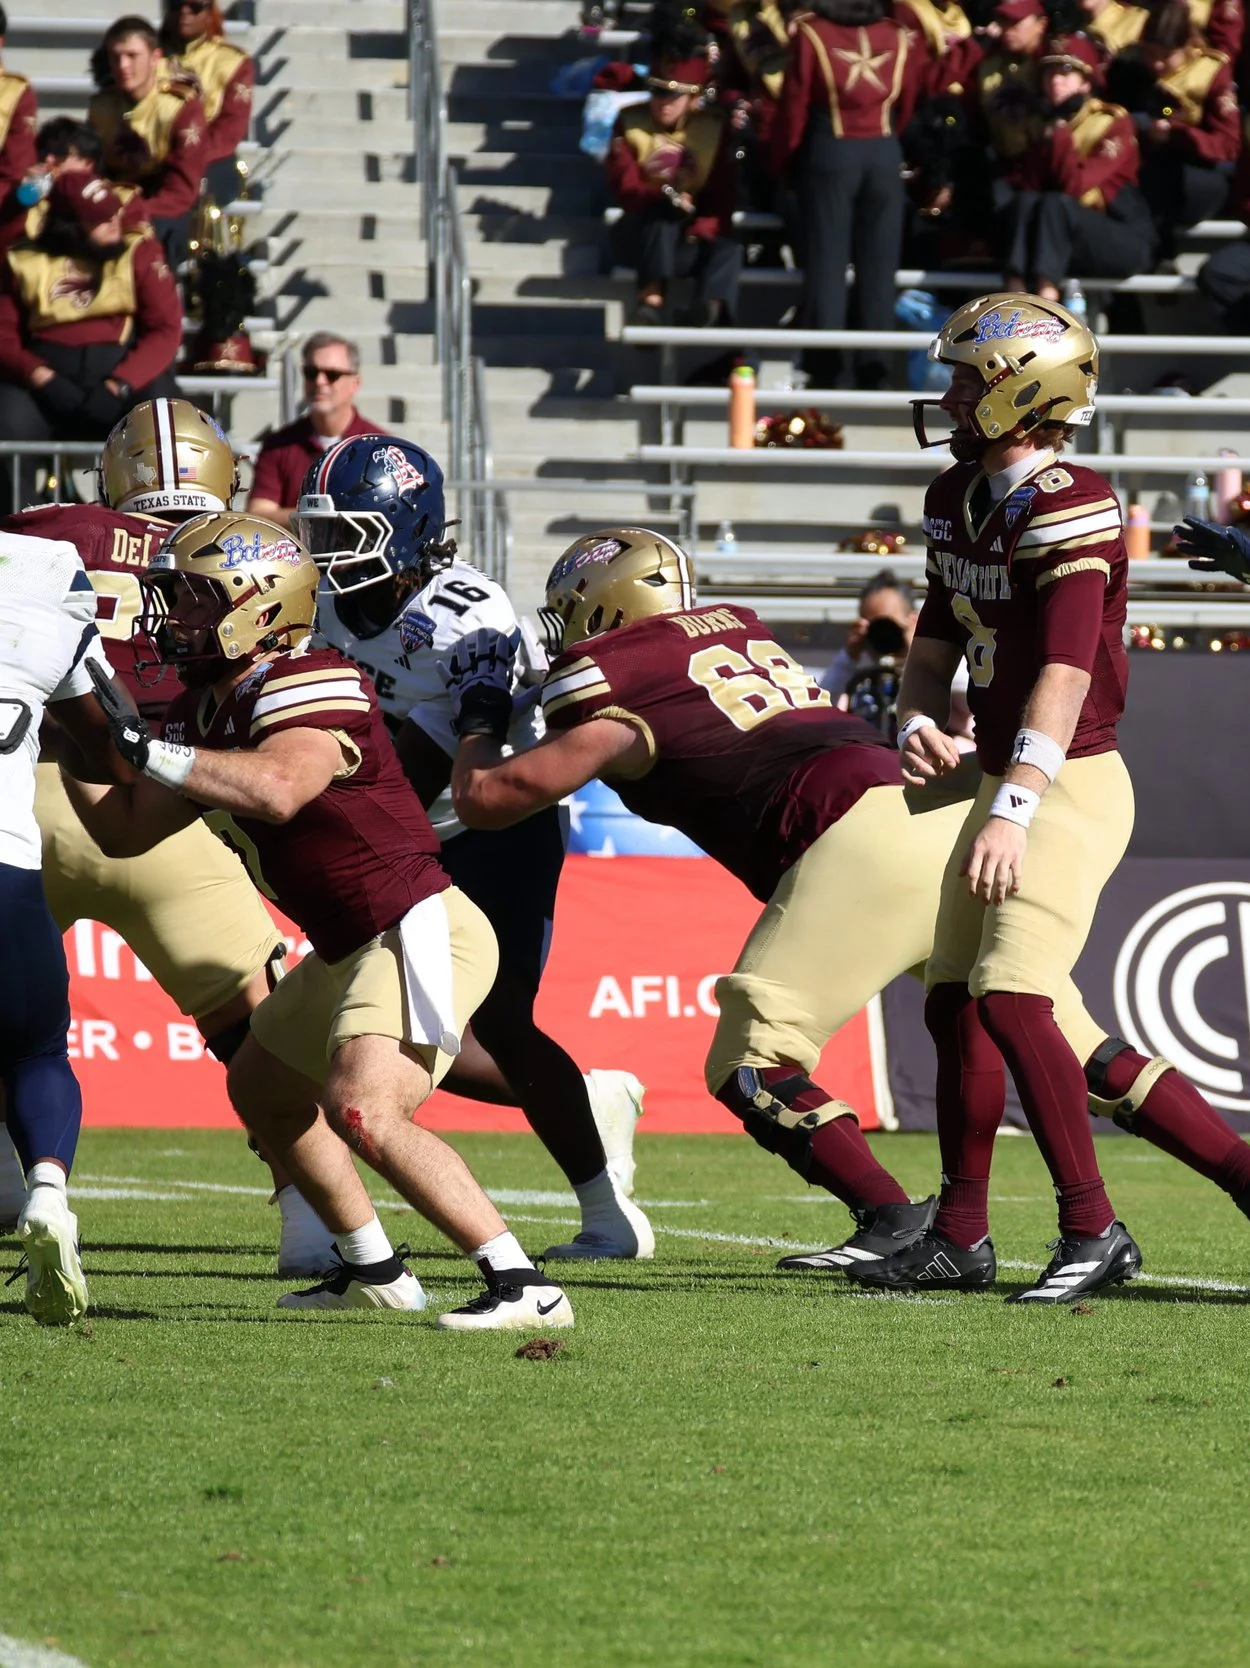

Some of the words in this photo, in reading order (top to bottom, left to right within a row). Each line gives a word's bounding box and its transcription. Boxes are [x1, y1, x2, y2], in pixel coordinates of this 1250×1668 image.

[1034, 467, 1075, 494] 8
[133, 495, 170, 512] TEXAS
[173, 493, 207, 507] STATE
[307, 497, 319, 508] WE
[428, 580, 491, 618] 16
[951, 592, 998, 688] 8
[688, 639, 832, 732] 68
[588, 973, 722, 1019] AFI.O
